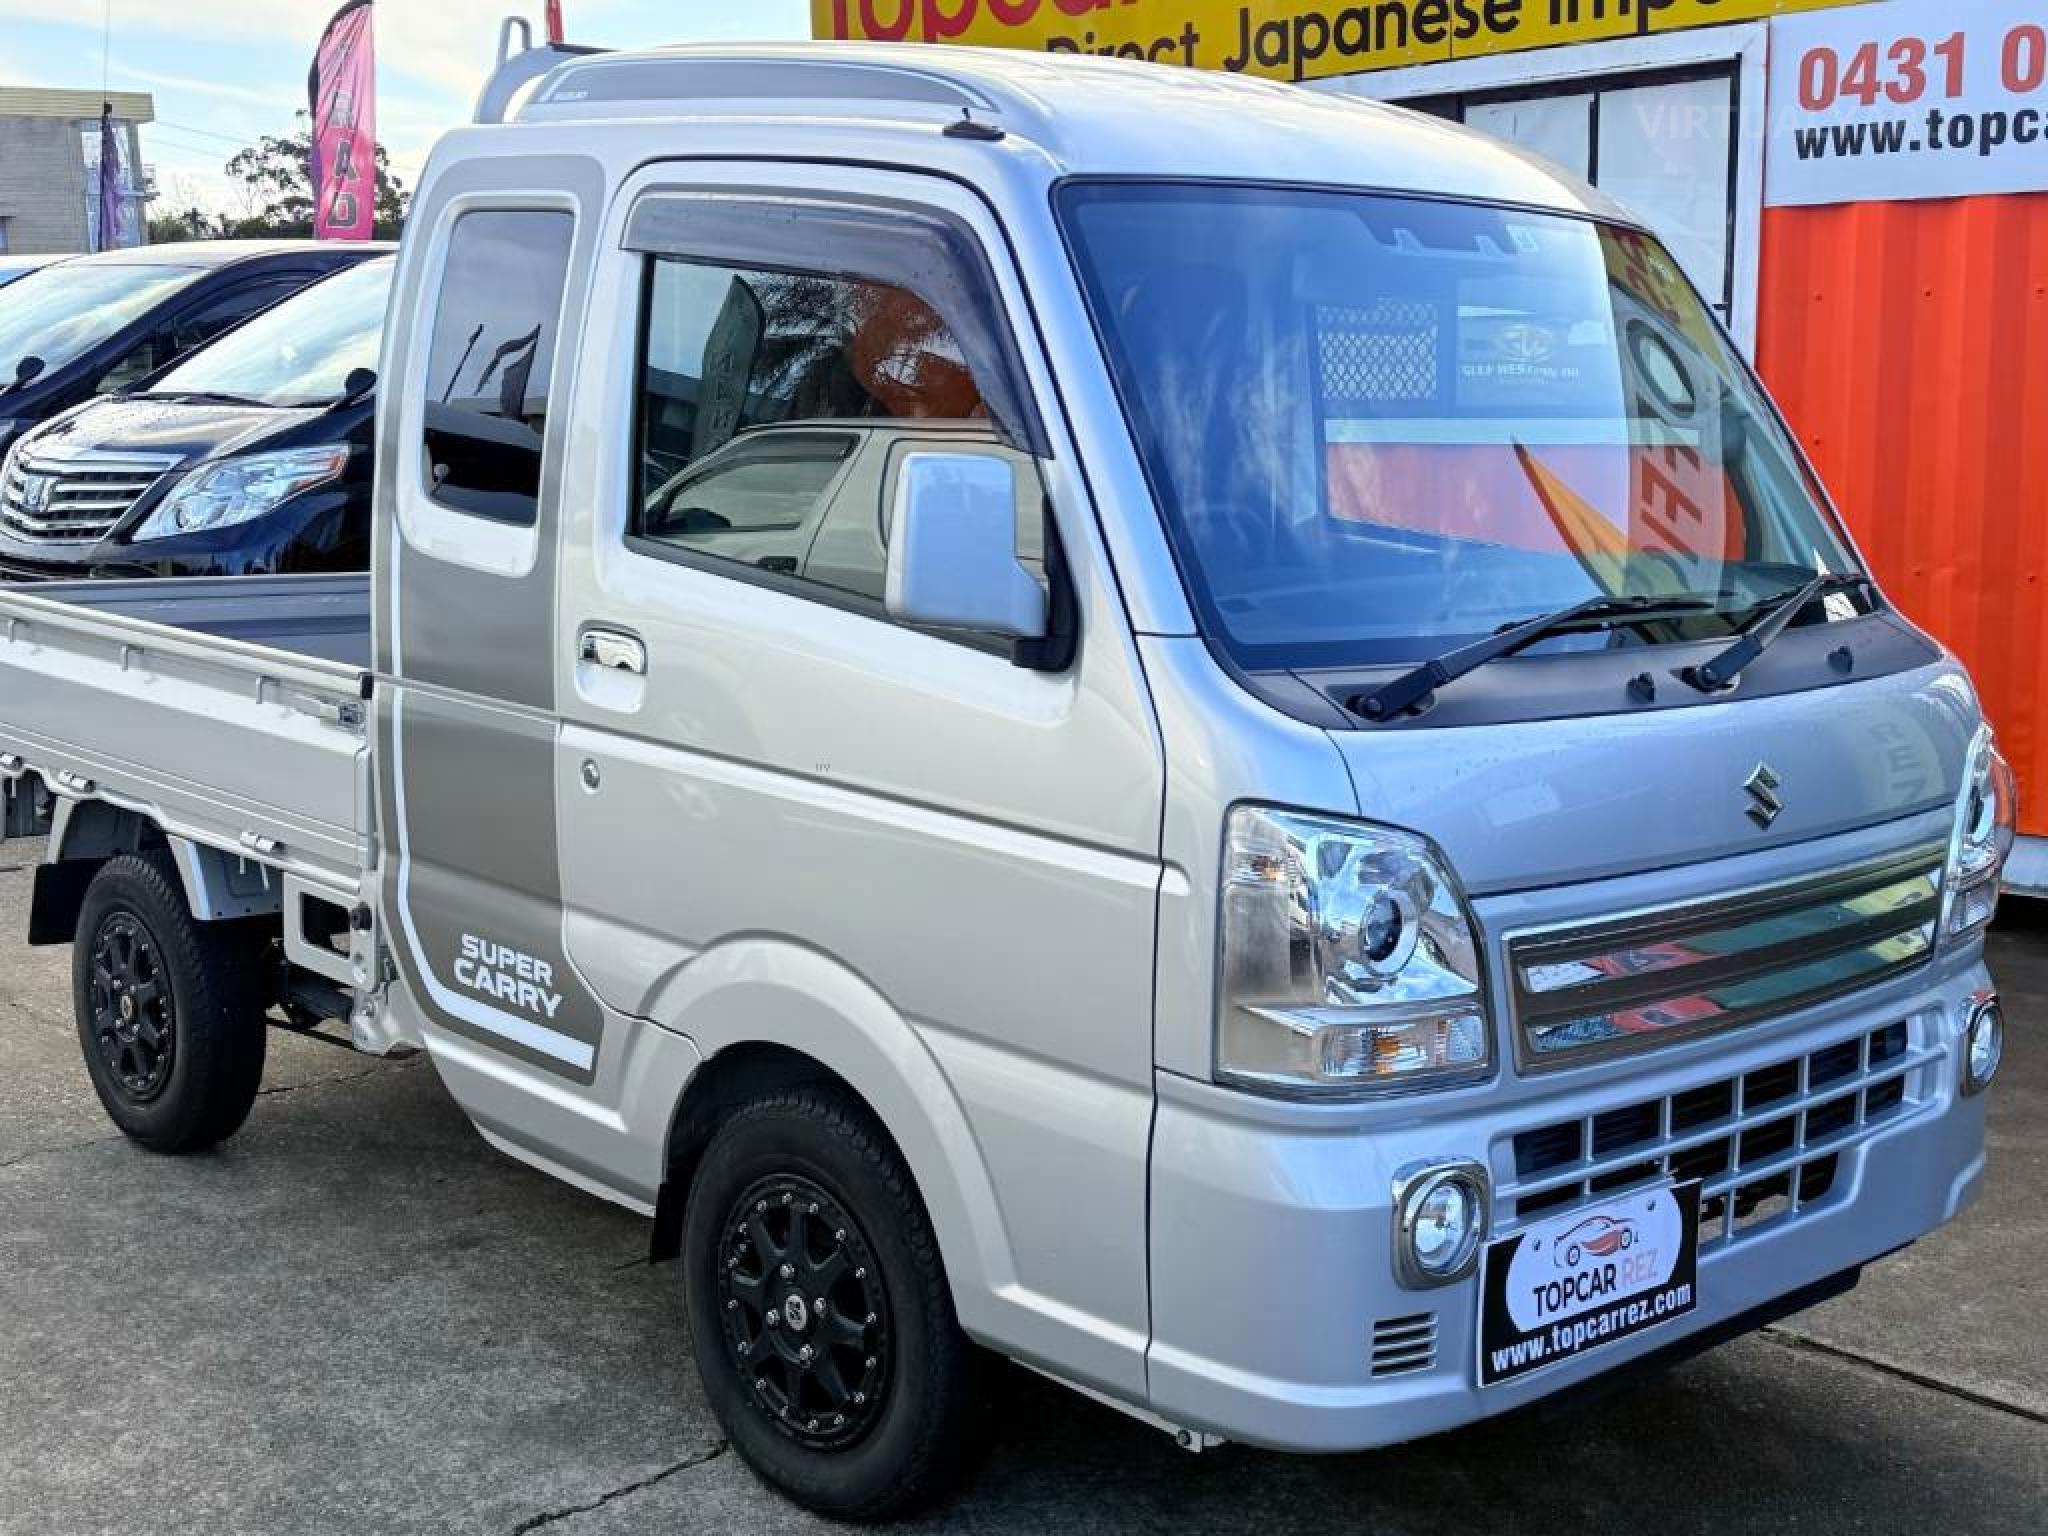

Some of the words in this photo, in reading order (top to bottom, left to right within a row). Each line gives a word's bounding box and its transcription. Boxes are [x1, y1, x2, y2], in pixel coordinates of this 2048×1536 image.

[1223, 0, 1521, 82] Japanese
[1799, 31, 1966, 112] 0431
[2001, 24, 2048, 92] 0
[1794, 107, 2048, 160] www.topc
[453, 957, 563, 1018] CARRY
[461, 933, 553, 987] SUPER
[1532, 1263, 1617, 1317] TOPCAR
[1620, 1247, 1660, 1286] REZ
[1491, 1283, 1692, 1373] www.topcarrez.com
